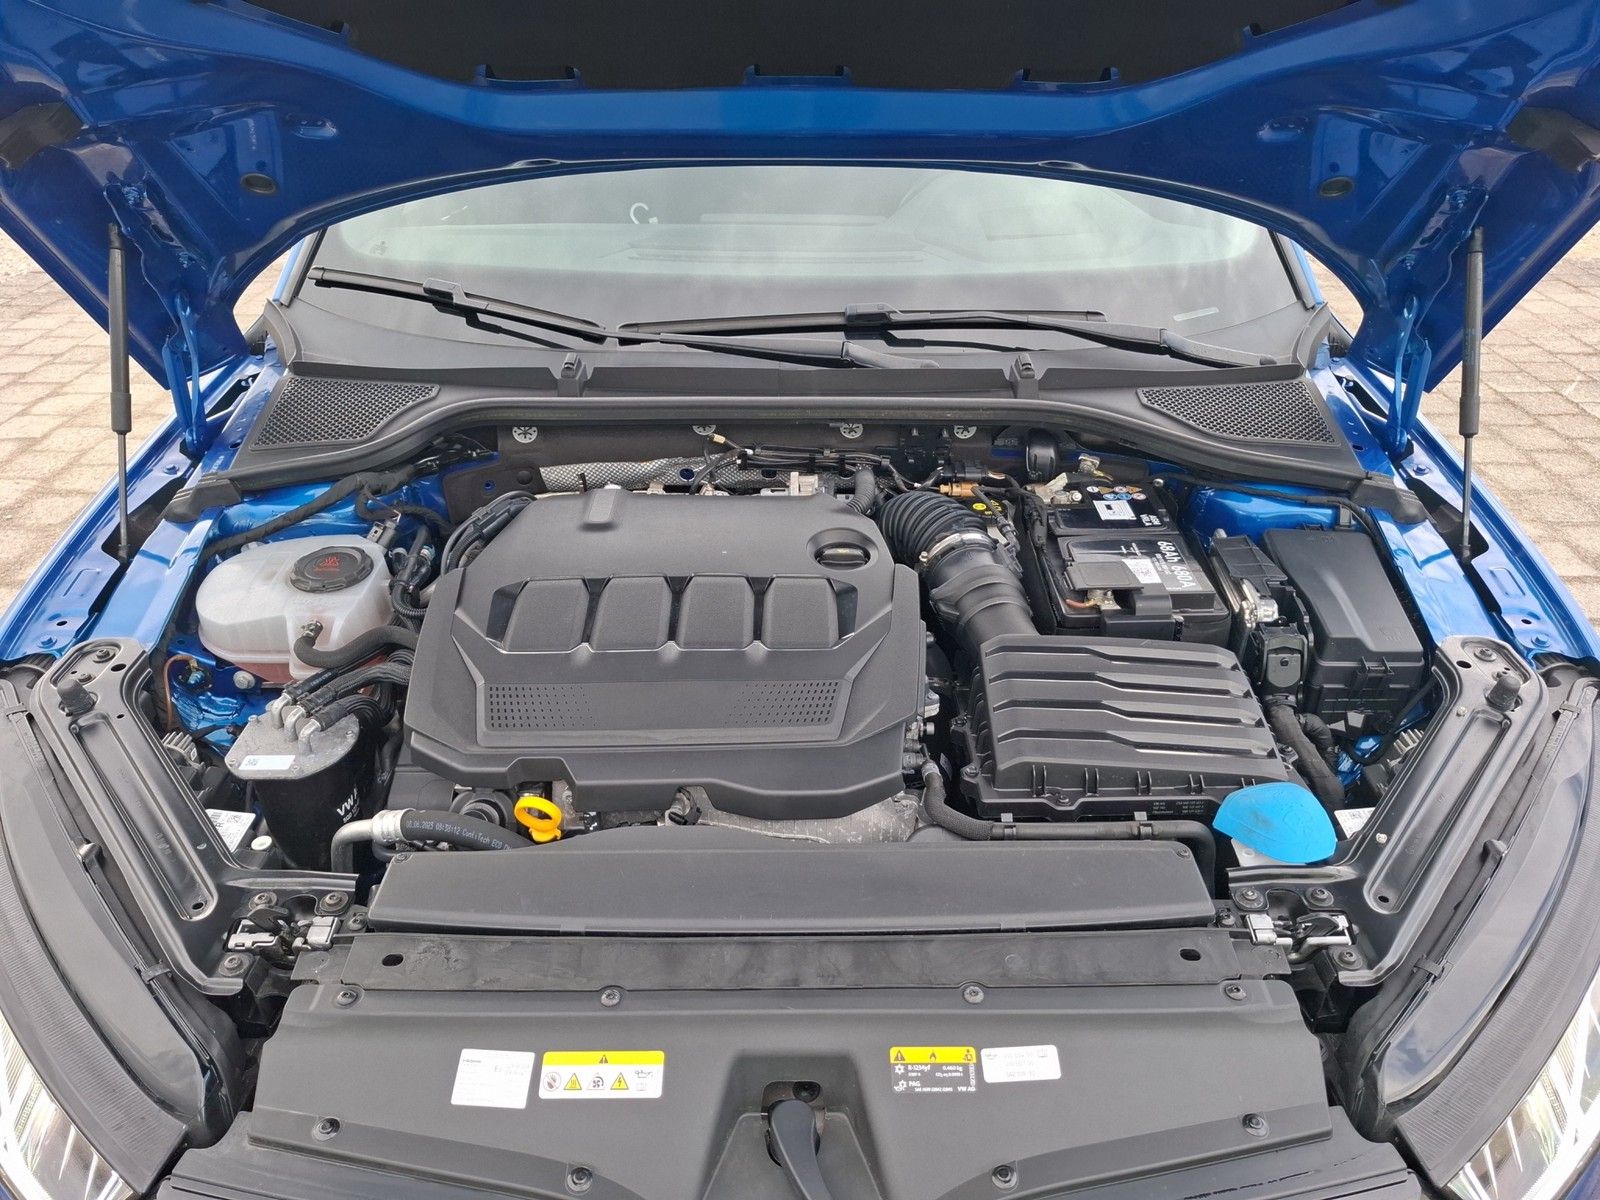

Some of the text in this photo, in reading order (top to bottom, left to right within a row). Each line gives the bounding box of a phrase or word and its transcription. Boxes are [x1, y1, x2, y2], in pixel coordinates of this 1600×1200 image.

[1157, 541, 1181, 563] 68Ah
[1172, 565, 1197, 588] 680A
[336, 794, 354, 816] VW
[461, 828, 491, 844] ContiTech
[908, 1064, 931, 1073] R-1234yf
